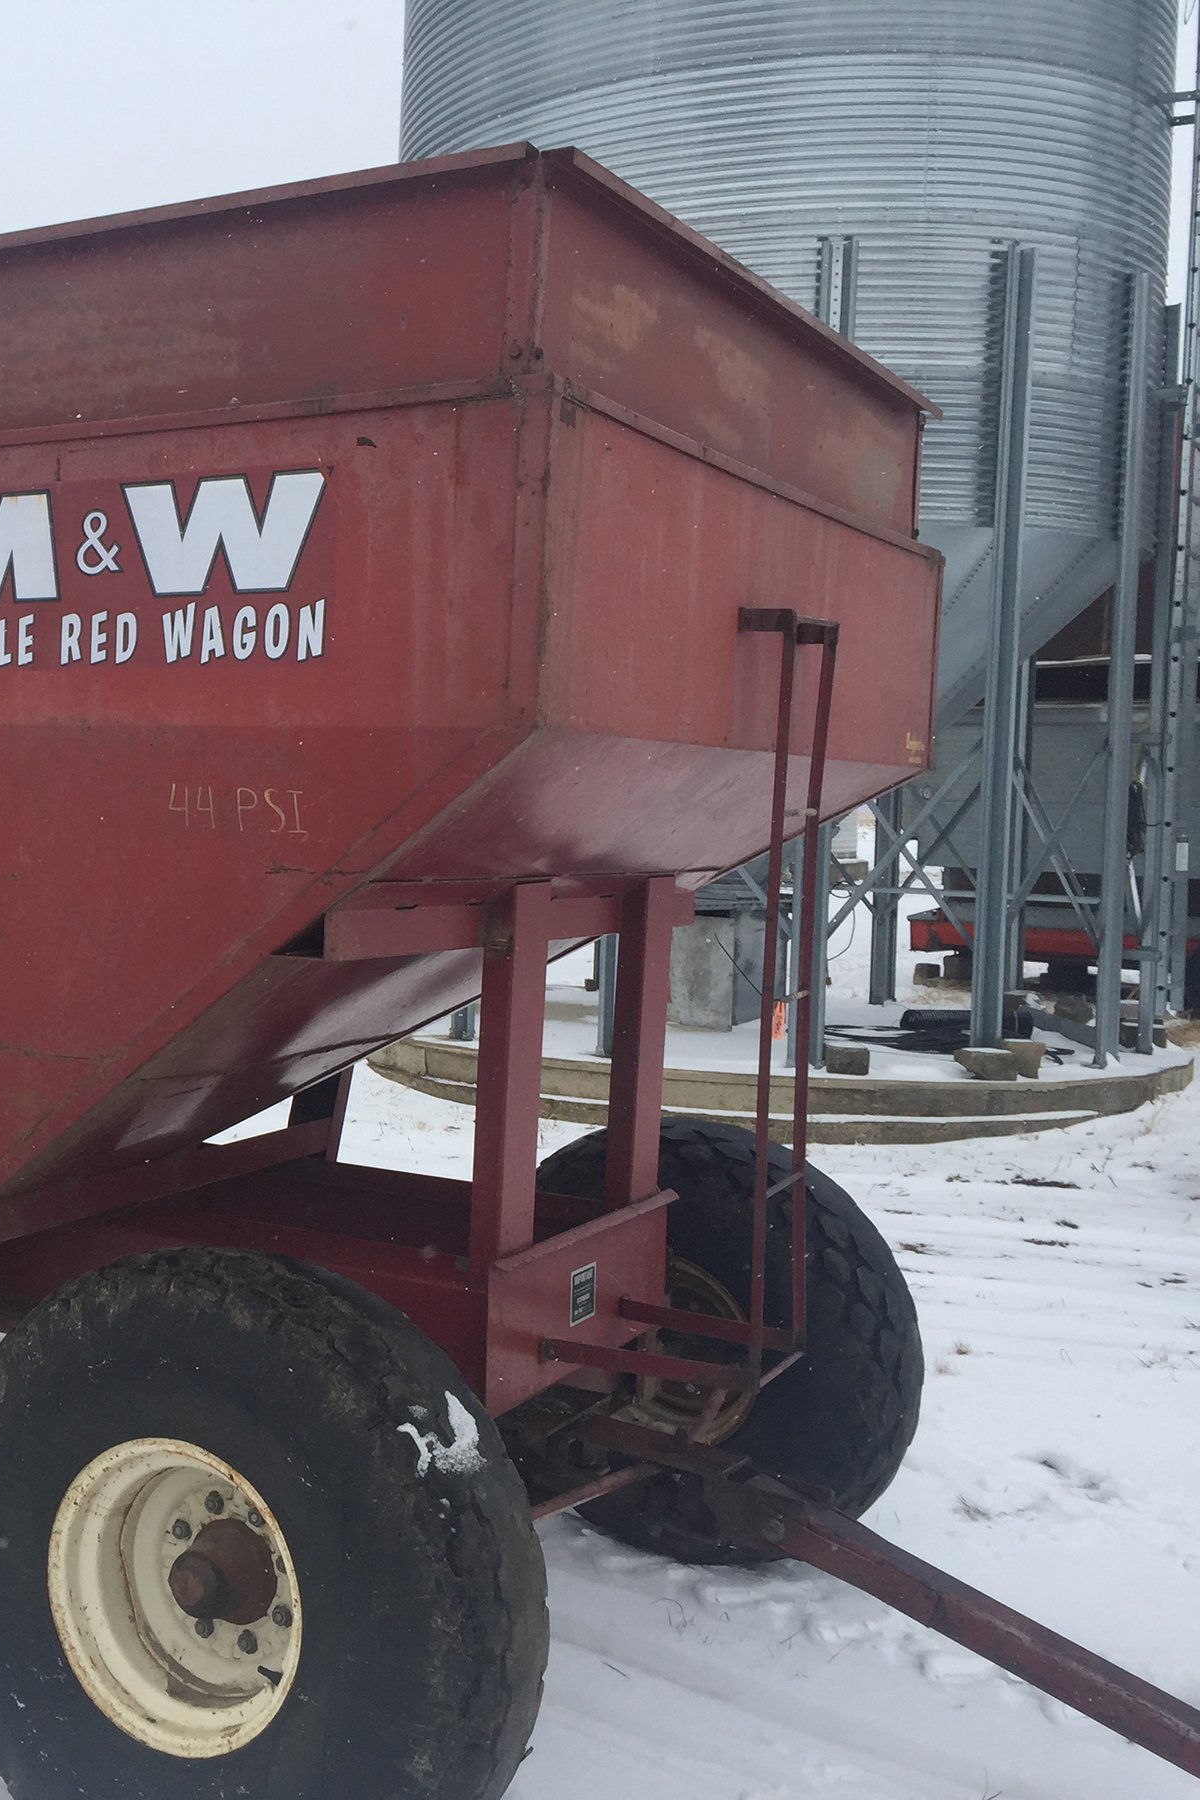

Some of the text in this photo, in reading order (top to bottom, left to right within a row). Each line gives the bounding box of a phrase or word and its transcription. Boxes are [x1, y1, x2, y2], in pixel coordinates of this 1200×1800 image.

[75, 510, 122, 575] &
[121, 468, 327, 596] W
[60, 610, 137, 665] RED
[162, 599, 326, 664] WAGON
[168, 783, 307, 834] 44 PSI
